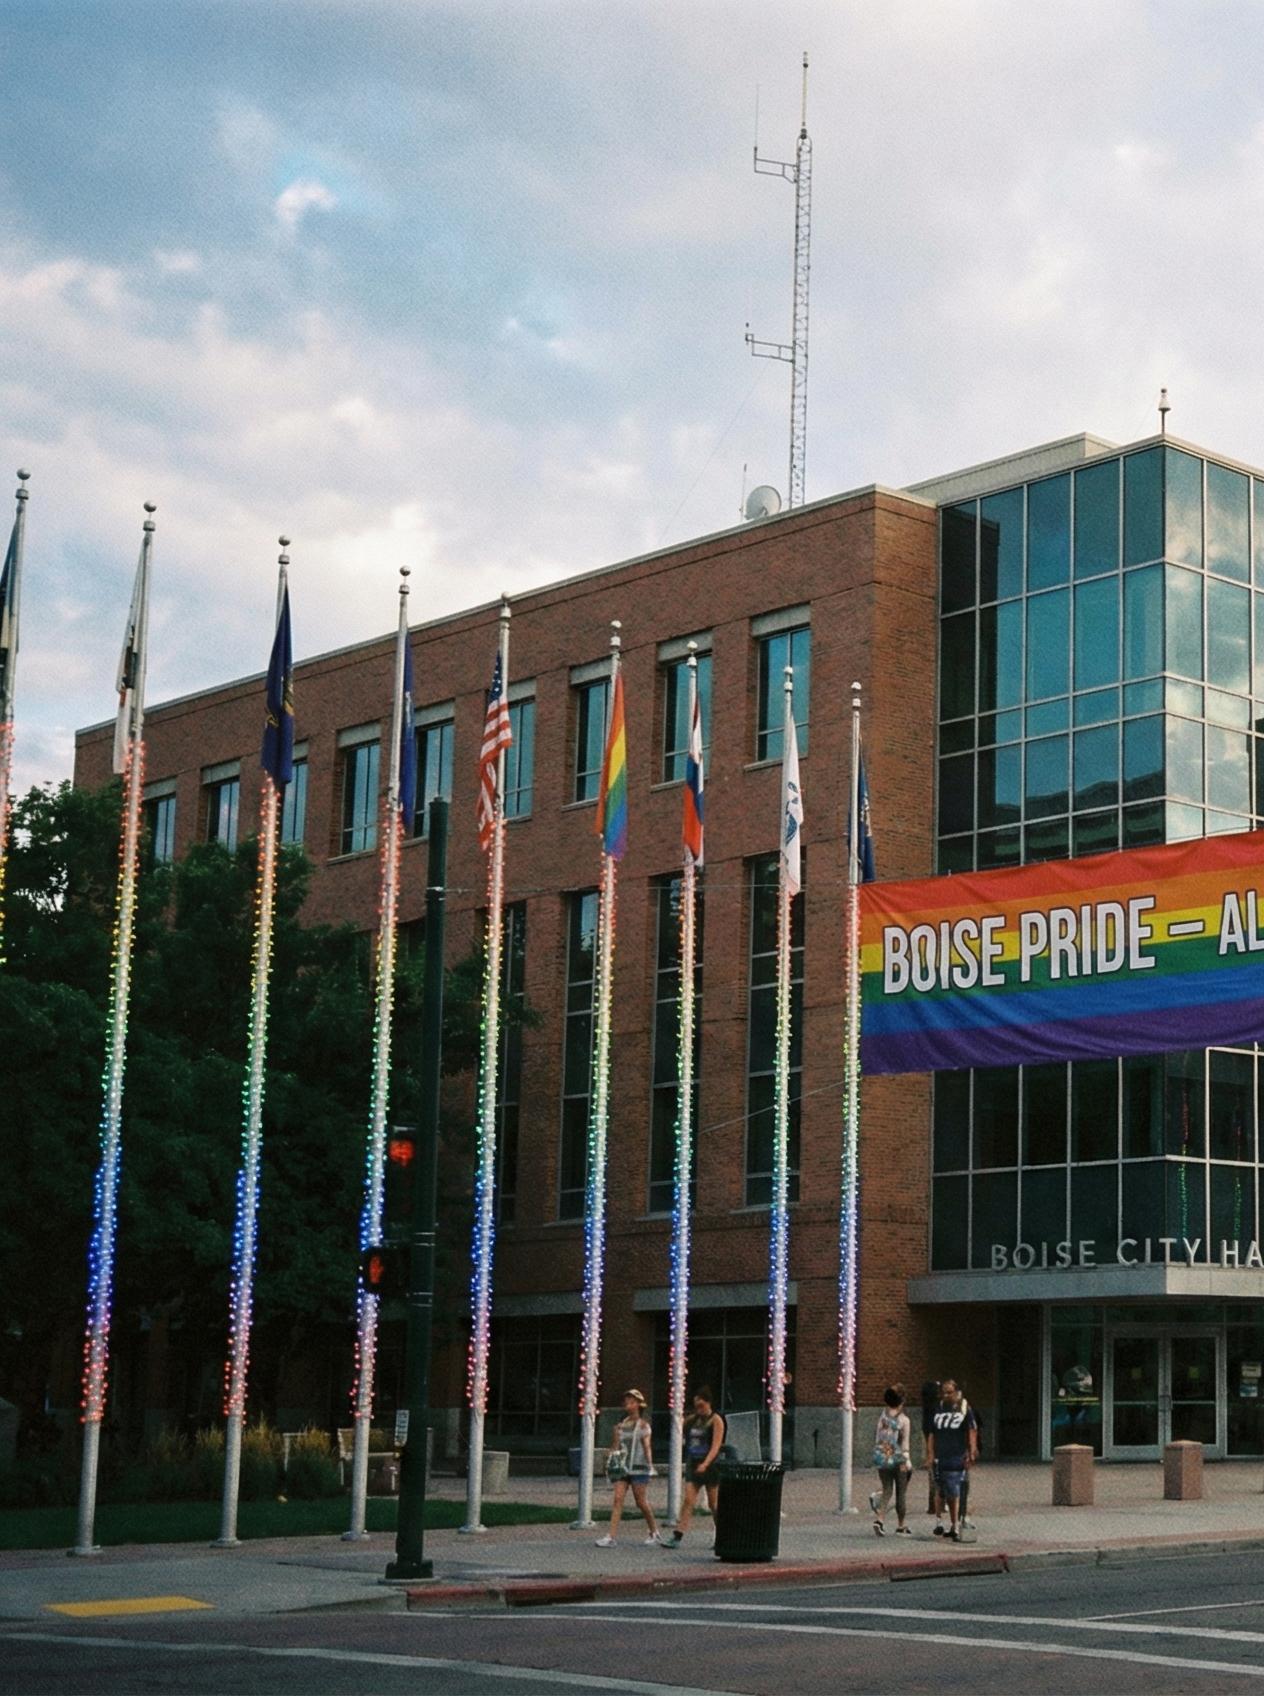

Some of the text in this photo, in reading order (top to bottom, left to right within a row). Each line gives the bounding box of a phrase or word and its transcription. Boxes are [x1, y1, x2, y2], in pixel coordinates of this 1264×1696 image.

[883, 915, 1006, 994] BOISE
[1019, 896, 1156, 983] PRIDE
[991, 1239, 1098, 1271] BOISE
[1116, 1237, 1202, 1267] CITY
